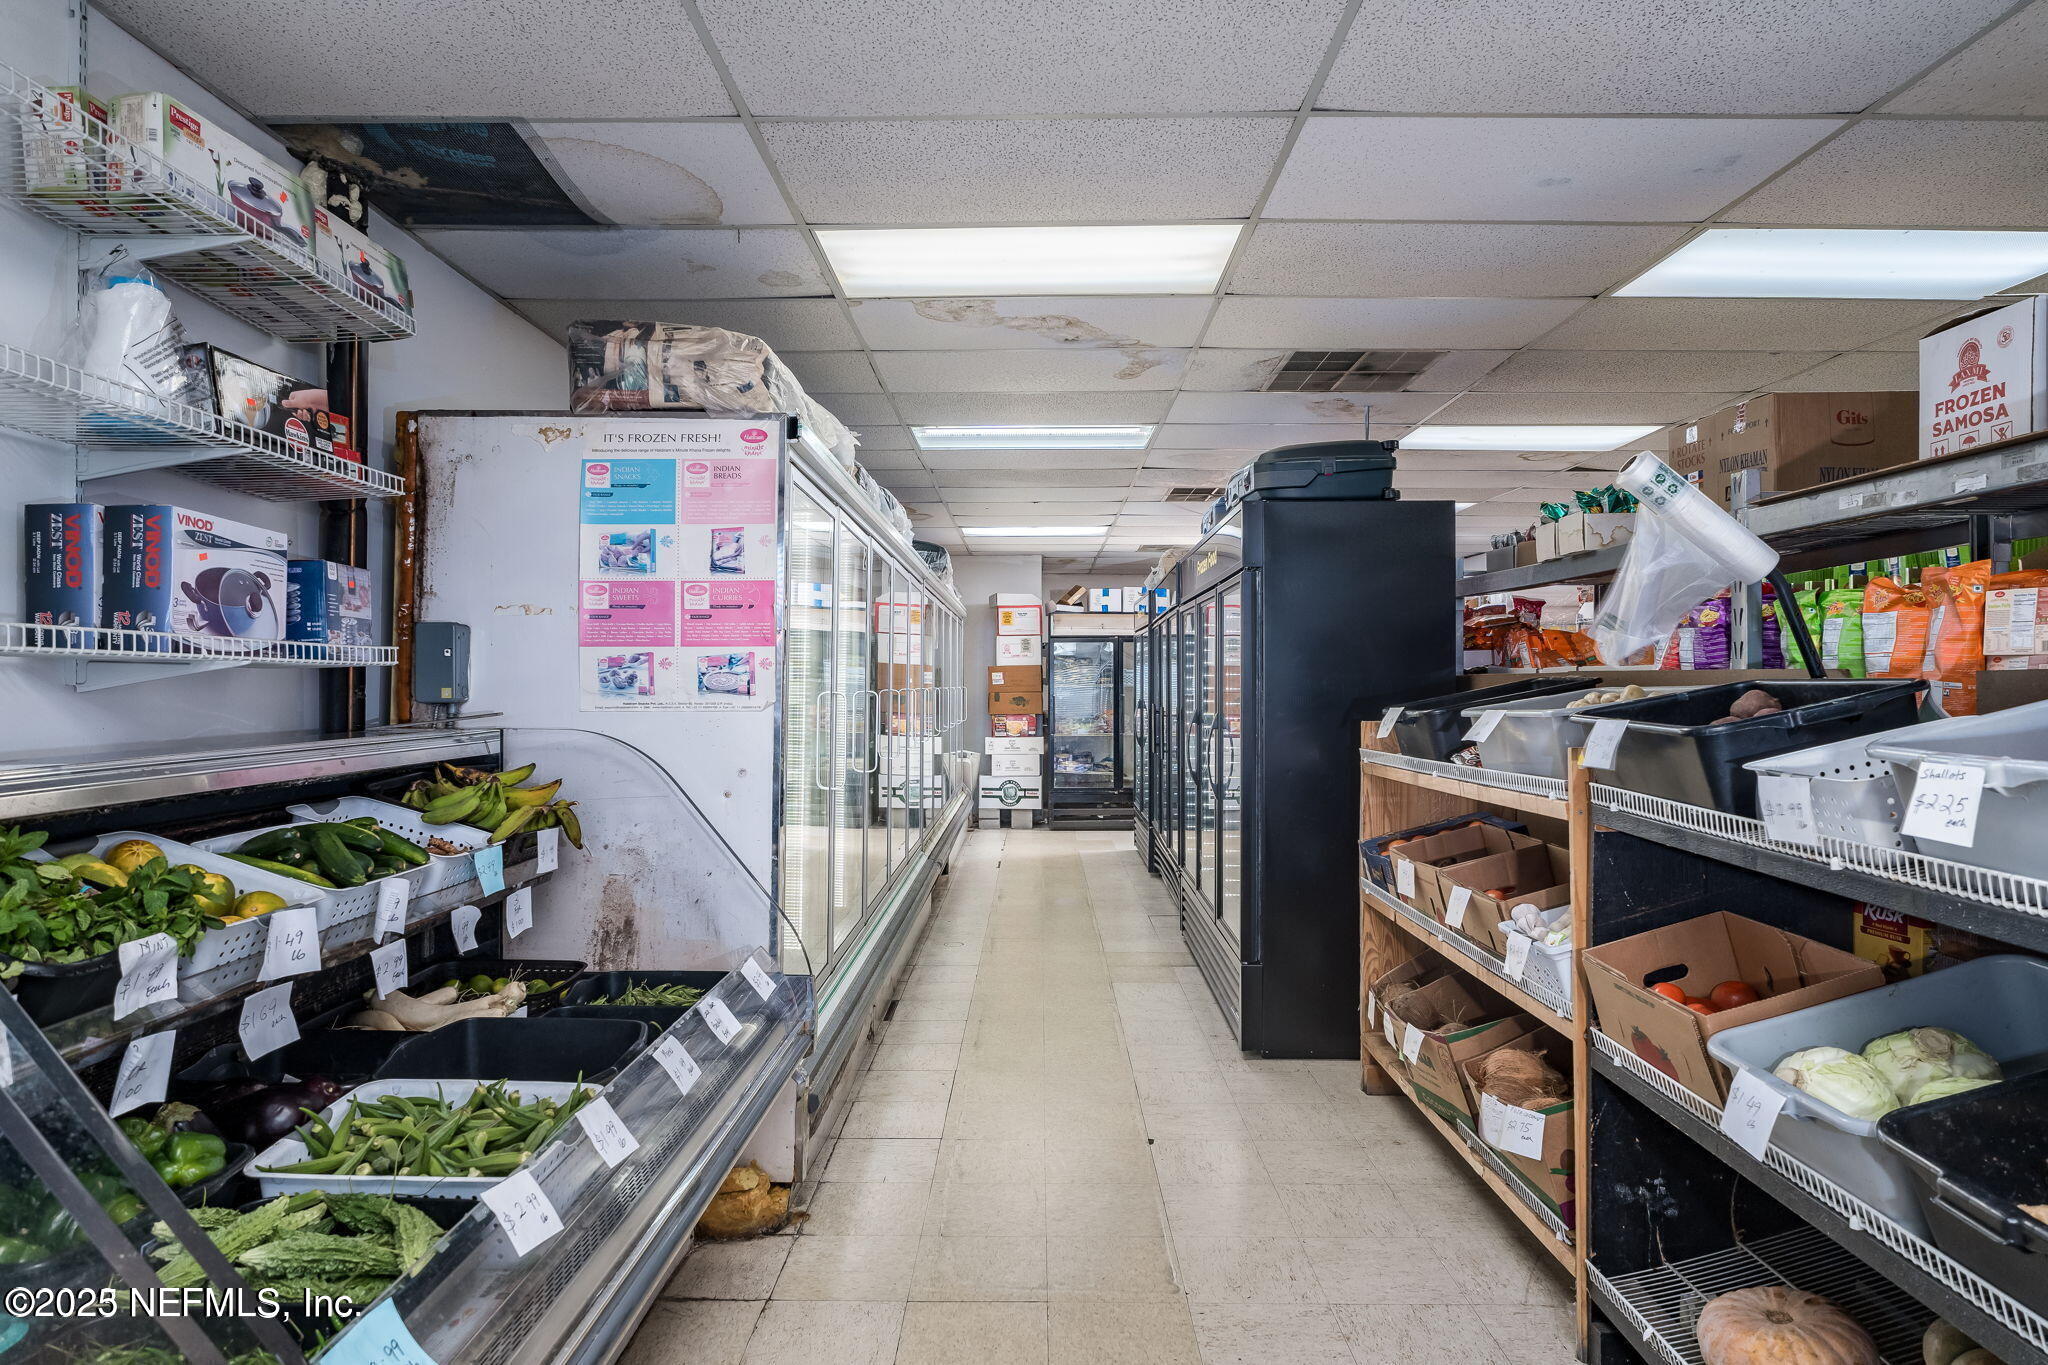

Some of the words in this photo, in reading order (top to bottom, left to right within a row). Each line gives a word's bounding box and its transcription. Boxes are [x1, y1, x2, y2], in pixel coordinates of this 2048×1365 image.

[170, 106, 200, 132] Prestige
[1935, 381, 2007, 418] FROZEN
[1836, 409, 1868, 425] Gits
[1932, 403, 2009, 438] SAMOSA
[603, 433, 624, 443] IT'S
[628, 433, 676, 443] FROZEN
[680, 433, 721, 443] FRESH!
[1677, 440, 1706, 456] ROTATE
[1677, 454, 1706, 470] STOCKS
[1719, 455, 1740, 473] NYLON
[1740, 449, 1768, 469] KHAMAN
[1819, 466, 1851, 483] NYLON
[51, 513, 63, 549] ZEST
[132, 513, 143, 549] ZEST
[177, 513, 214, 532] VINOD
[194, 531, 213, 544] ZEST
[64, 513, 82, 589] VINOD
[145, 514, 161, 588] VINOD
[40, 611, 53, 626] 12
[118, 610, 131, 626] 12
[1920, 767, 1967, 782] Shallots
[1944, 817, 1967, 828] each
[1866, 928, 1889, 938] PREMIUM
[139, 936, 169, 958] MINT
